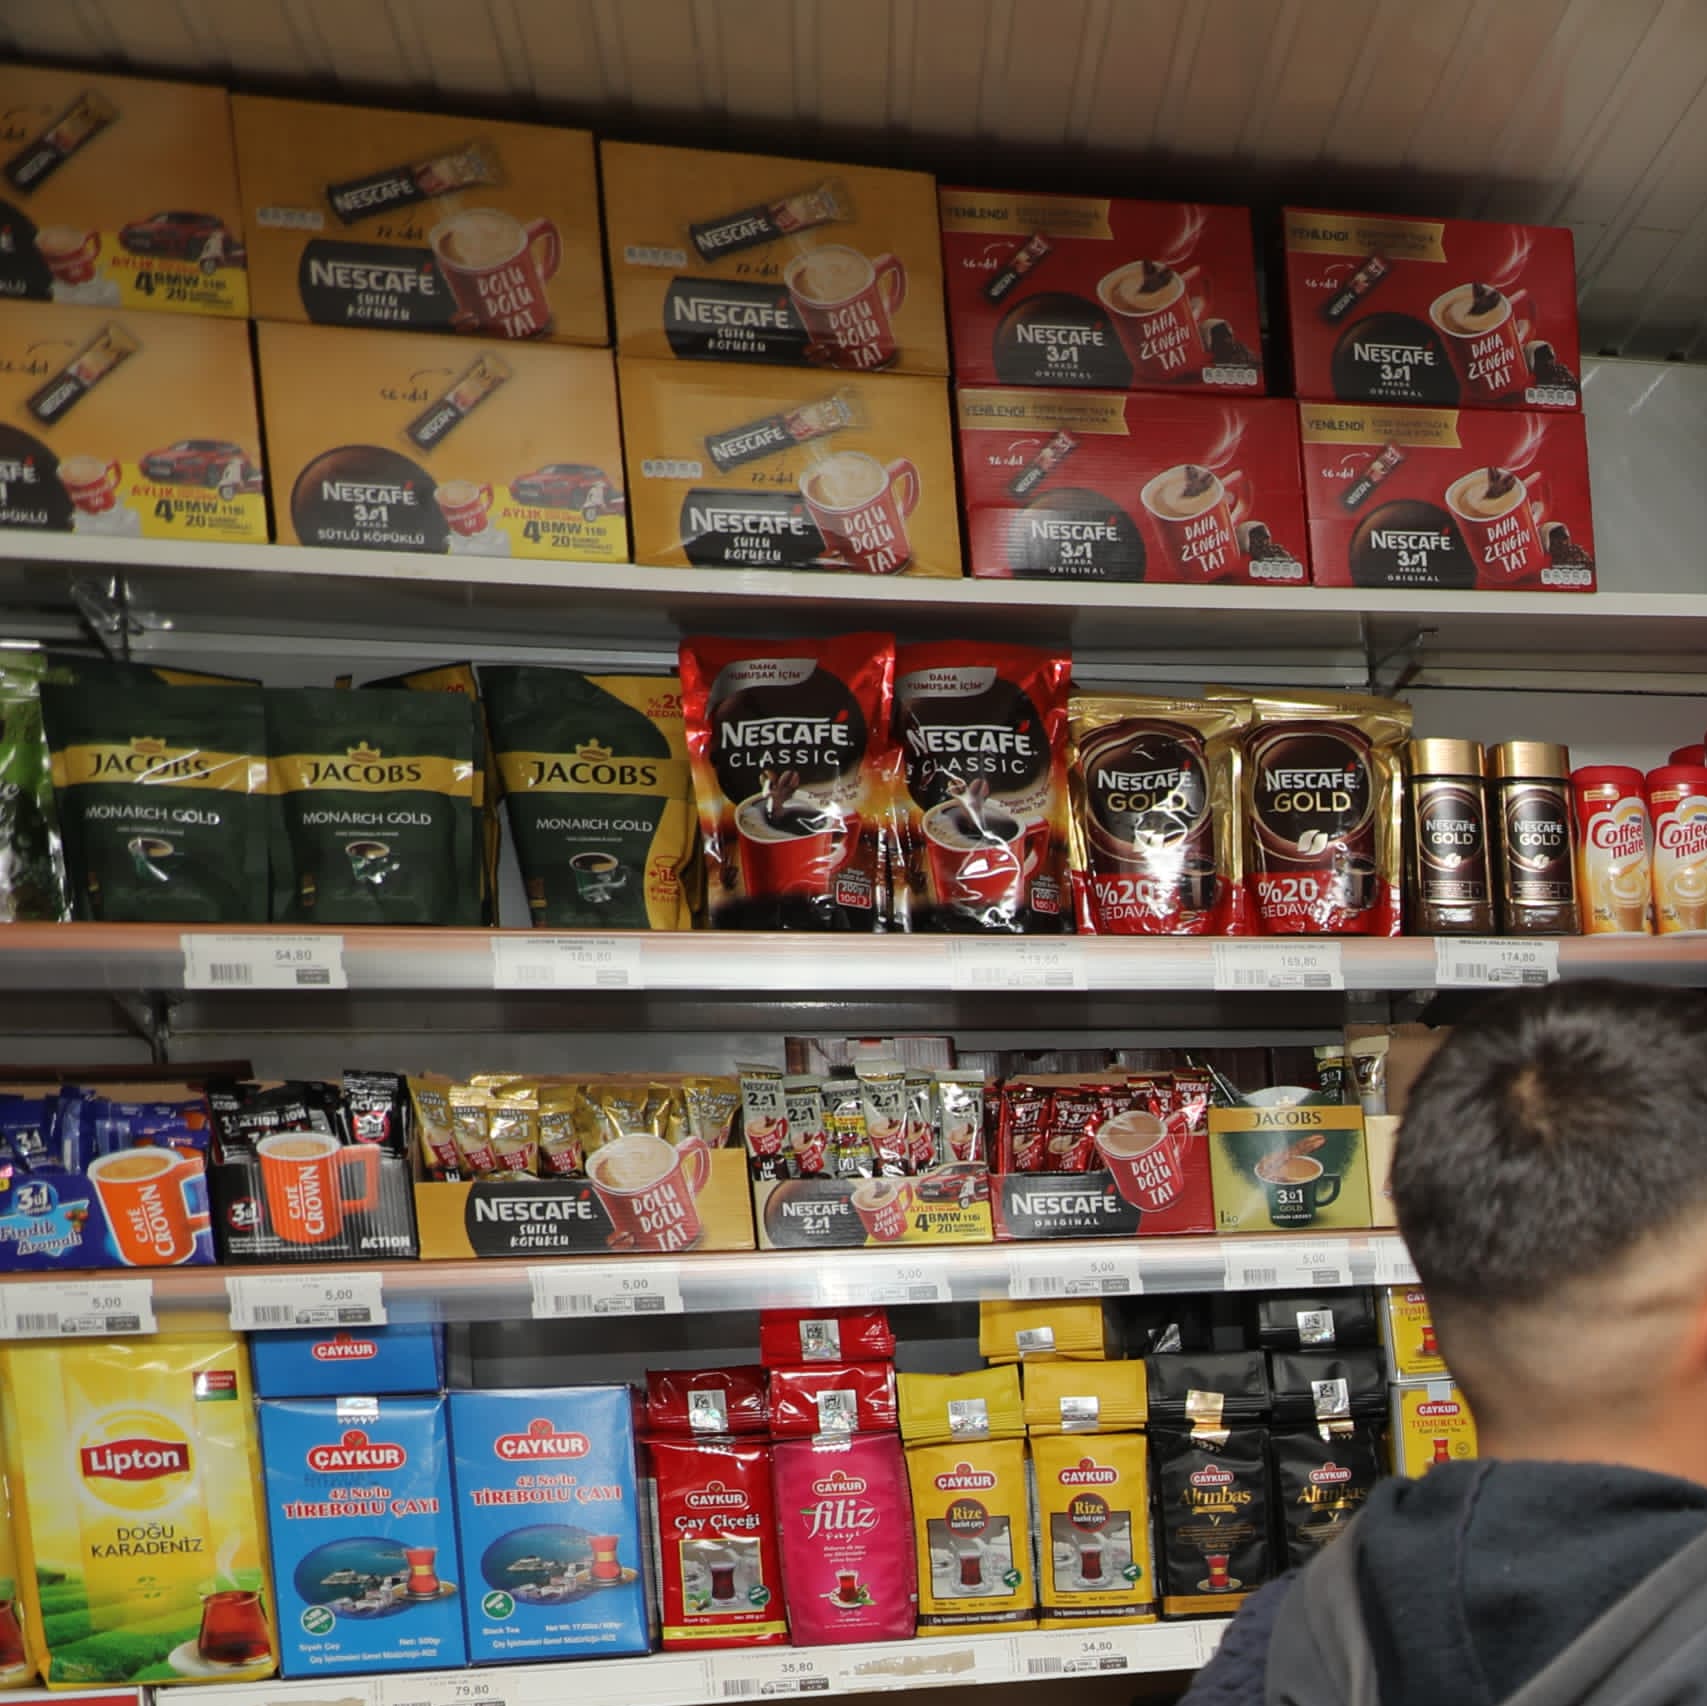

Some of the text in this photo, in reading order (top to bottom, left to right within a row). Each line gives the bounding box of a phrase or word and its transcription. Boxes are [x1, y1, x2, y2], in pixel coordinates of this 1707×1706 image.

[92, 753, 210, 781] JACOBS
[729, 749, 839, 768] CLASSIC
[922, 757, 1026, 774] CLASSIC
[307, 762, 421, 785] JACOBS
[532, 760, 657, 787] JACOBS
[1107, 793, 1187, 813] GOLD
[1273, 793, 1351, 813] GOLD
[303, 812, 432, 826] MONARCH GOLD
[535, 818, 654, 832] MONARCH GOLD
[1432, 832, 1473, 846] GOLD
[1519, 832, 1560, 846] GOLD
[1258, 879, 1318, 904] %20
[1252, 1112, 1322, 1127] JACOBS
[304, 1165, 325, 1235] CROWN
[153, 1185, 175, 1257] CROWN
[915, 1213, 929, 1231] 4
[1034, 1217, 1101, 1226] ORIGINAL
[360, 1234, 412, 1249] ACTION
[90, 1444, 180, 1474] Lipton
[471, 1484, 623, 1505] TİREBOLU ÇAYI
[283, 1496, 440, 1519] TİREBOLU ÇAYI
[951, 1508, 983, 1521] Rize
[674, 1512, 760, 1531] Çay Çiçeği
[805, 1500, 877, 1541] filiz
[116, 1522, 176, 1542] DOĞU
[90, 1536, 204, 1558] KARADENİZ
